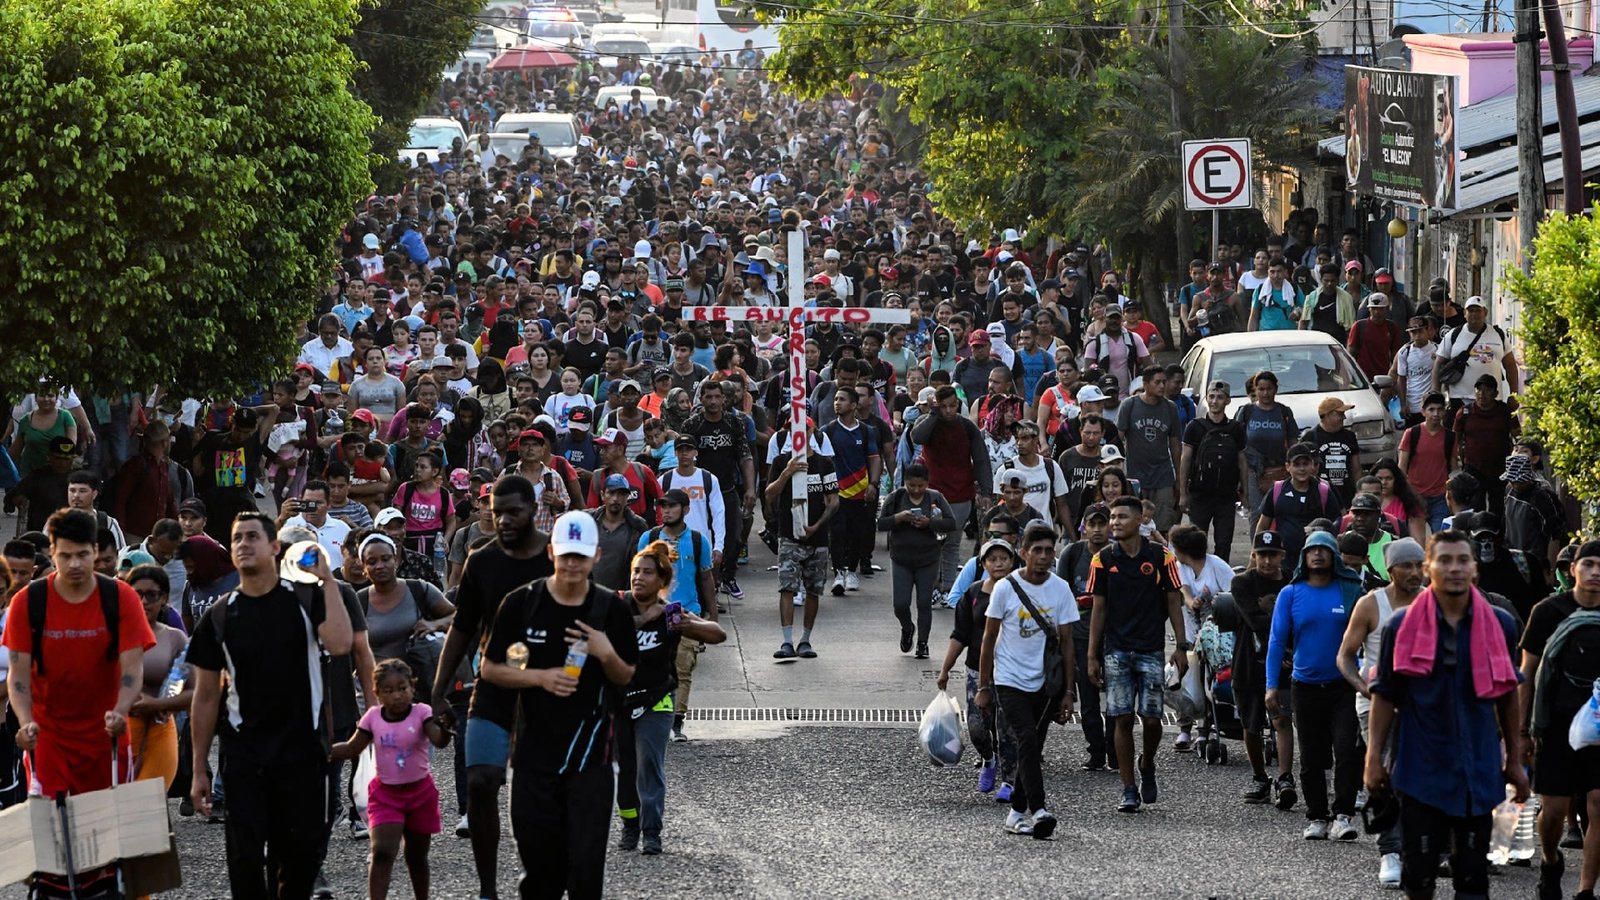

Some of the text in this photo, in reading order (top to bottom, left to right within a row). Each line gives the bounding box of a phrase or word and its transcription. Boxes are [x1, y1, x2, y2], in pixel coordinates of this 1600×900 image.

[1369, 72, 1425, 98] AUTOLAVADO
[1203, 156, 1232, 194] E
[789, 306, 806, 452] CRISTO
[1135, 418, 1169, 432] KINGS
[1248, 419, 1282, 430] updox
[636, 631, 658, 646] IKE
